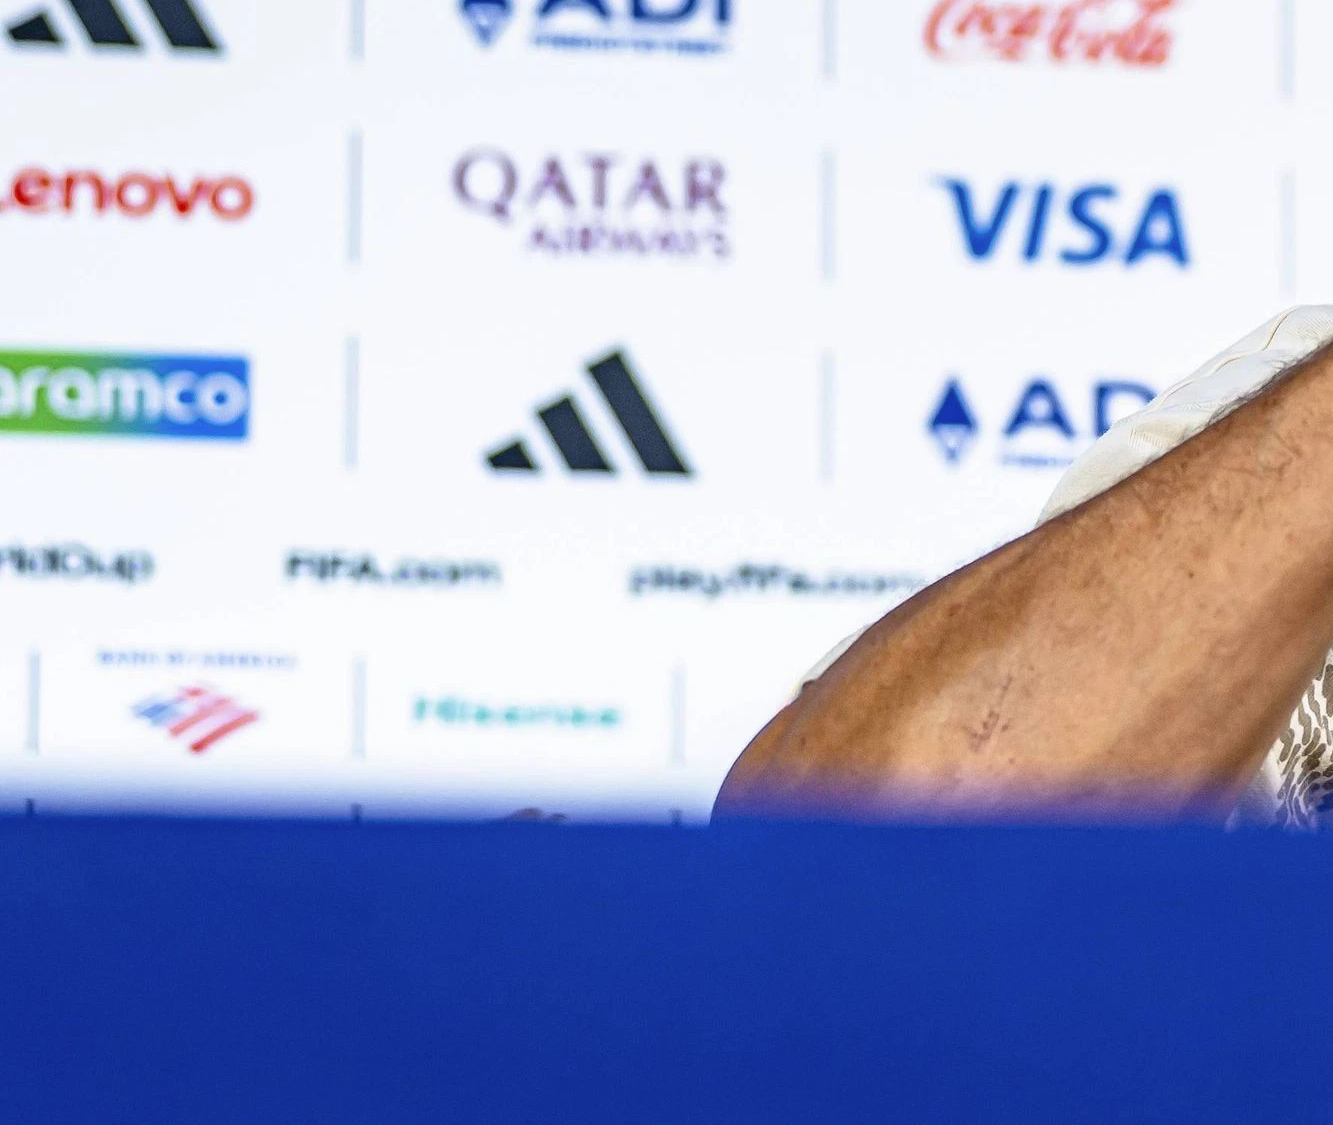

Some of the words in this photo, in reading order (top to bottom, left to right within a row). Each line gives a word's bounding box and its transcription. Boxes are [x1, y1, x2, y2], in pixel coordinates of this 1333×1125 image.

[0, 166, 255, 221] enovo
[450, 147, 730, 222] QATAR
[938, 175, 1192, 270] VISA
[1002, 376, 1160, 440] AD
